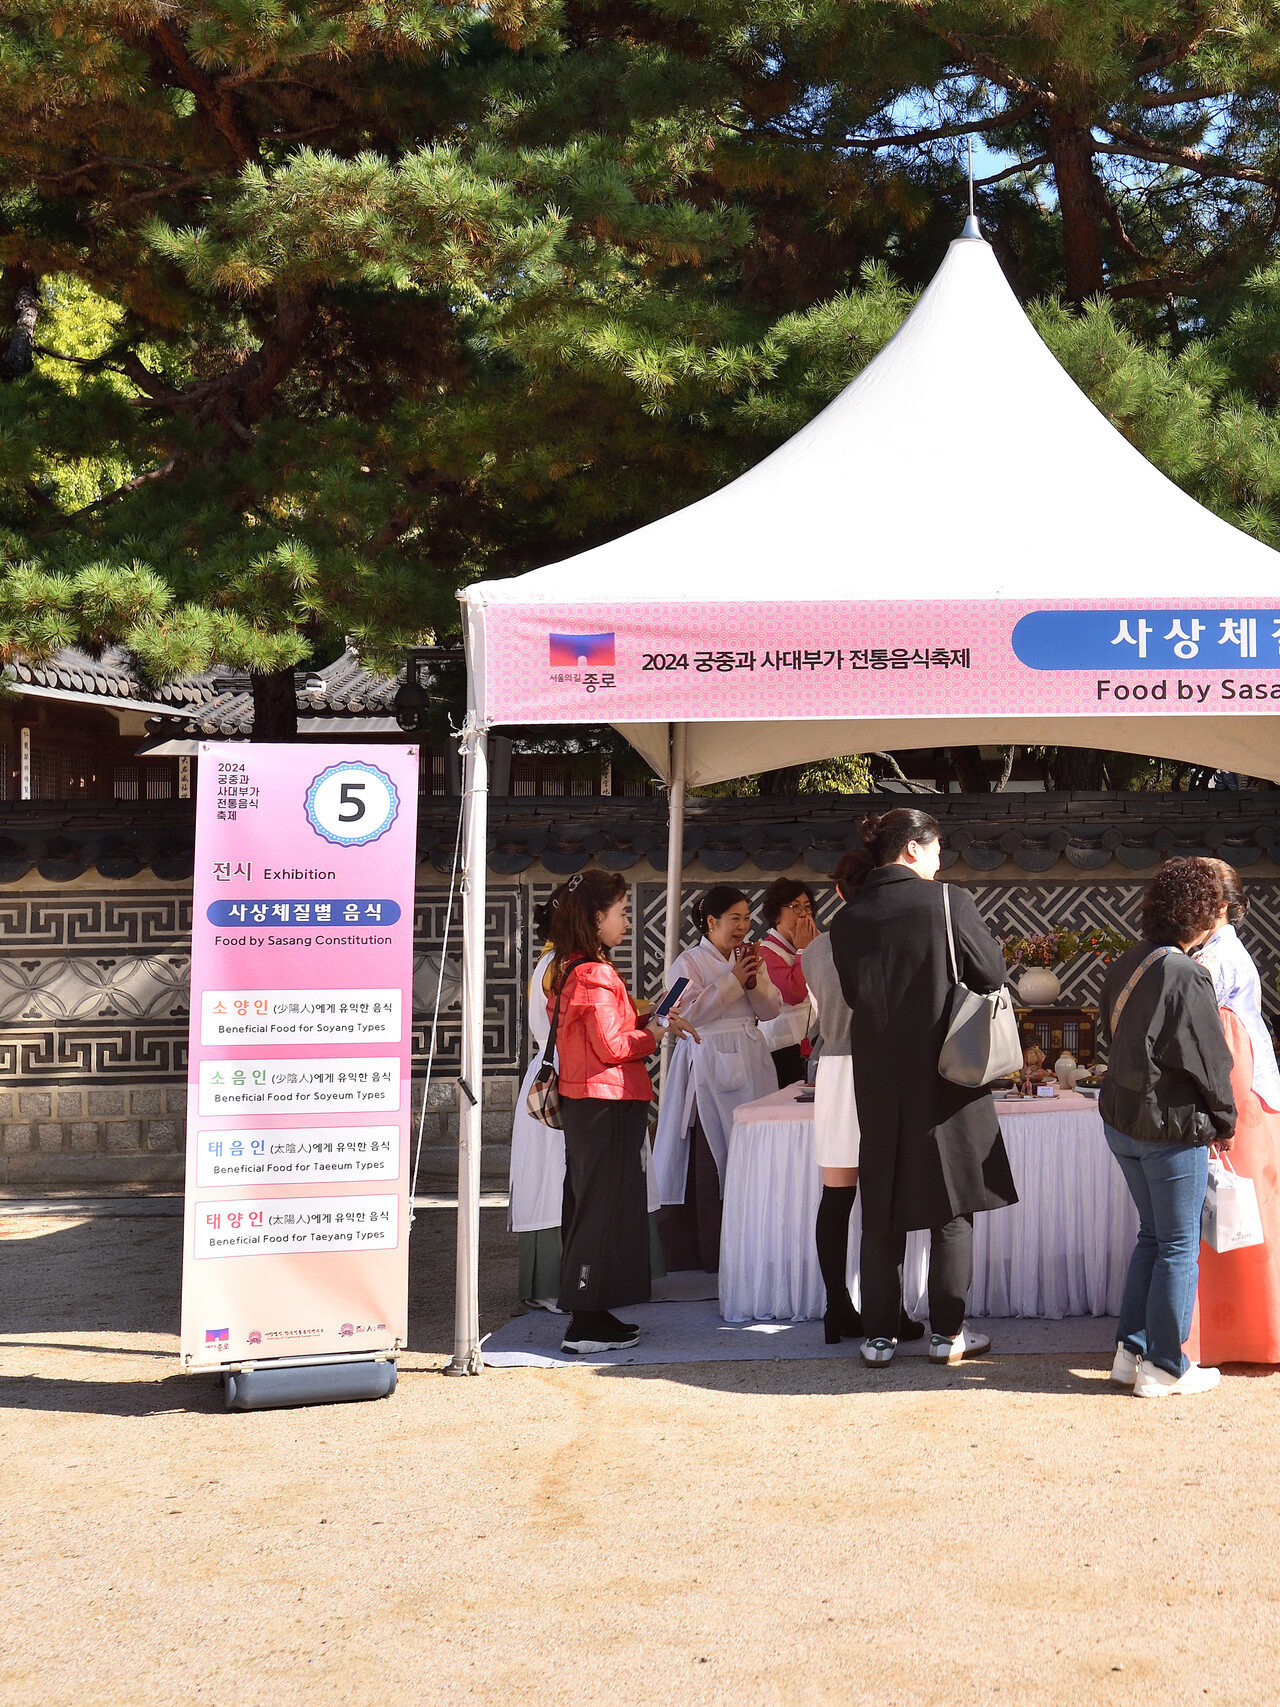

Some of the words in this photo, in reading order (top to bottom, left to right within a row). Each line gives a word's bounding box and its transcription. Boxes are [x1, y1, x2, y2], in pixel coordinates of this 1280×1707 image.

[641, 653, 689, 671] 2024
[693, 651, 756, 671] 궁중과
[760, 649, 845, 671] 사대부가
[848, 648, 971, 670] 전통음식축제
[582, 673, 617, 693] 종로
[1097, 679, 1167, 700] Food
[1178, 679, 1210, 703] by
[218, 763, 245, 772] 2024
[218, 774, 250, 785] 궁중과
[217, 786, 260, 796] 사대부가
[217, 798, 259, 809] 전통음식
[338, 783, 366, 822] 5
[217, 810, 237, 821] 축제
[212, 862, 252, 882] 전시
[263, 868, 336, 880] Exhibition
[228, 903, 333, 923] 사상체질별
[342, 903, 382, 922] 음식
[215, 936, 246, 946] Food
[250, 936, 265, 948] by
[268, 935, 312, 947] Sasang
[315, 934, 392, 946] Constitution
[212, 999, 268, 1016] 소양인
[339, 1003, 369, 1013] 유익한
[373, 1003, 392, 1013] 음식
[218, 1025, 268, 1033] Beneficial
[270, 1024, 296, 1033] Food
[299, 1024, 314, 1032] for
[317, 1024, 354, 1034] Soyang
[357, 1023, 386, 1032] Types
[209, 1069, 266, 1086] 소음인
[337, 1072, 368, 1083] 유익한
[371, 1071, 391, 1082] 음식
[214, 1093, 265, 1102] Beneficial
[267, 1093, 293, 1101] Food
[295, 1092, 311, 1101] for
[314, 1092, 353, 1102] Soyeum
[357, 1091, 385, 1100] Types
[208, 1140, 265, 1157] 태음인
[336, 1142, 367, 1152] 유익한
[370, 1141, 390, 1151] 음식
[213, 1164, 264, 1174] Beneficial
[267, 1163, 293, 1172] Food
[295, 1163, 310, 1171] for
[313, 1162, 352, 1171] Taeeum
[356, 1161, 385, 1170] Types
[206, 1211, 263, 1230] 태양인
[335, 1212, 366, 1223] 유익한
[369, 1211, 389, 1221] 음식
[209, 1236, 260, 1246] Beneficial
[263, 1234, 289, 1243] Food
[292, 1233, 307, 1242] for
[310, 1232, 353, 1243] Taeyang
[356, 1230, 385, 1240] Types
